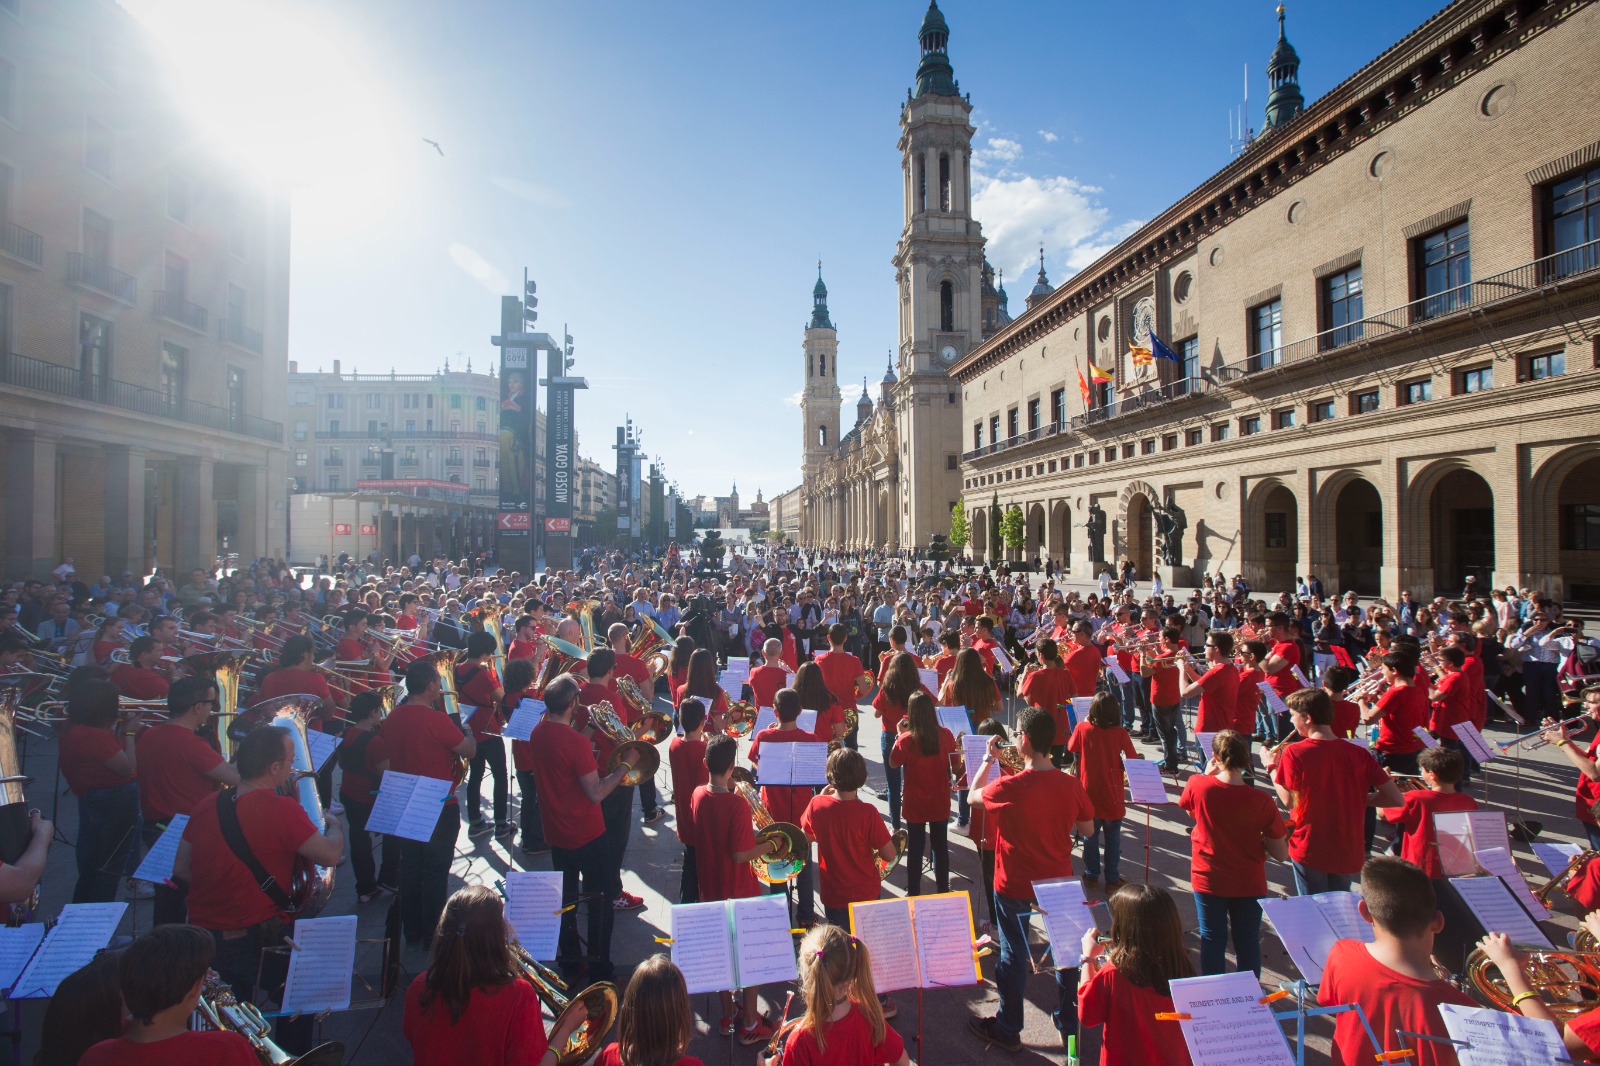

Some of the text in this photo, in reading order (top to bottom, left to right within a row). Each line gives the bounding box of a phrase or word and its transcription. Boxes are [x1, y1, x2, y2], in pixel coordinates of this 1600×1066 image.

[555, 443, 568, 503] MUSEO GOYA
[1188, 999, 1215, 1008] TRUMPET
[1215, 997, 1231, 1006] TUNE
[1231, 996, 1244, 1004] AND
[1463, 1018, 1496, 1028] TRUMPET
[1517, 1027, 1534, 1035] AND
